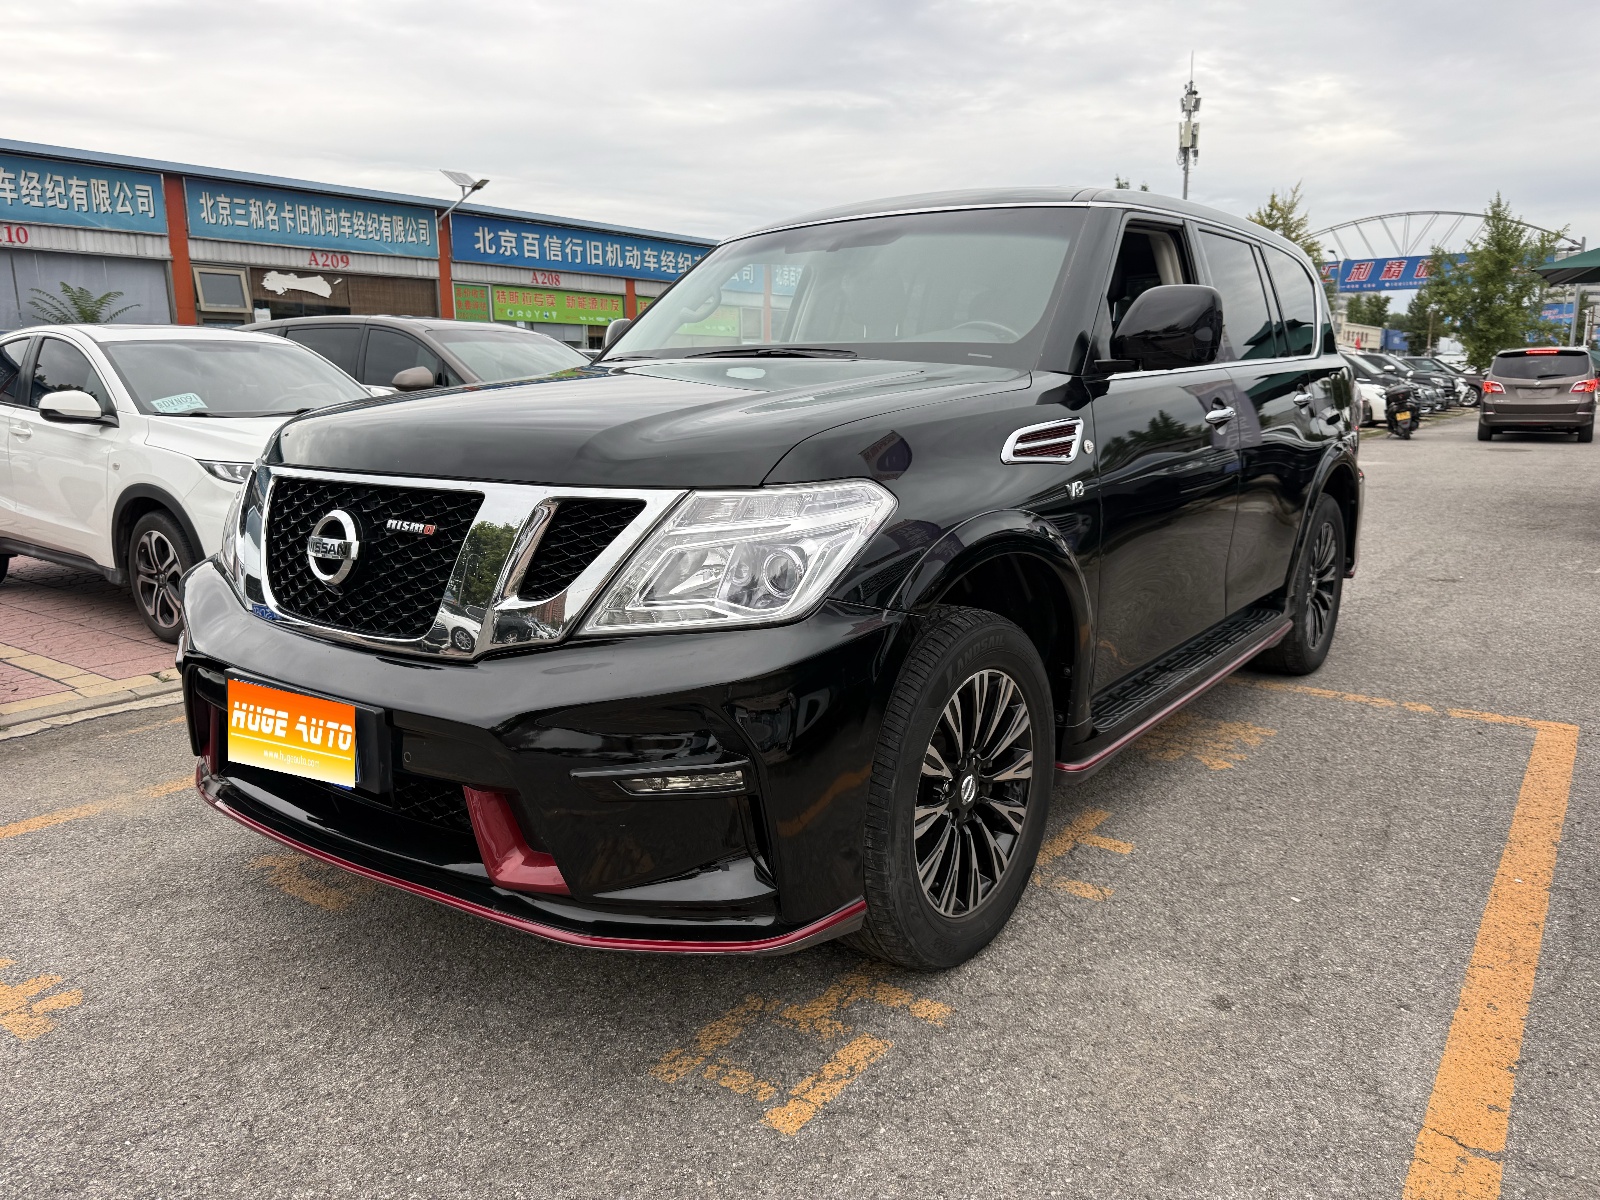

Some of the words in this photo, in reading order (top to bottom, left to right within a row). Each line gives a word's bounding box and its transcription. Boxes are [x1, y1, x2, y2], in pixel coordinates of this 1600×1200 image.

[0, 167, 155, 218] 车经纪有限公司
[199, 191, 431, 246] 北京三和名卡旧机动车经纪有限公司
[0, 225, 28, 244] 10
[308, 251, 350, 268] A209
[474, 226, 703, 274] 北京百信行旧机动车经纪
[530, 271, 561, 287] A208
[1065, 480, 1085, 500] V8
[308, 537, 348, 556] NISSAN
